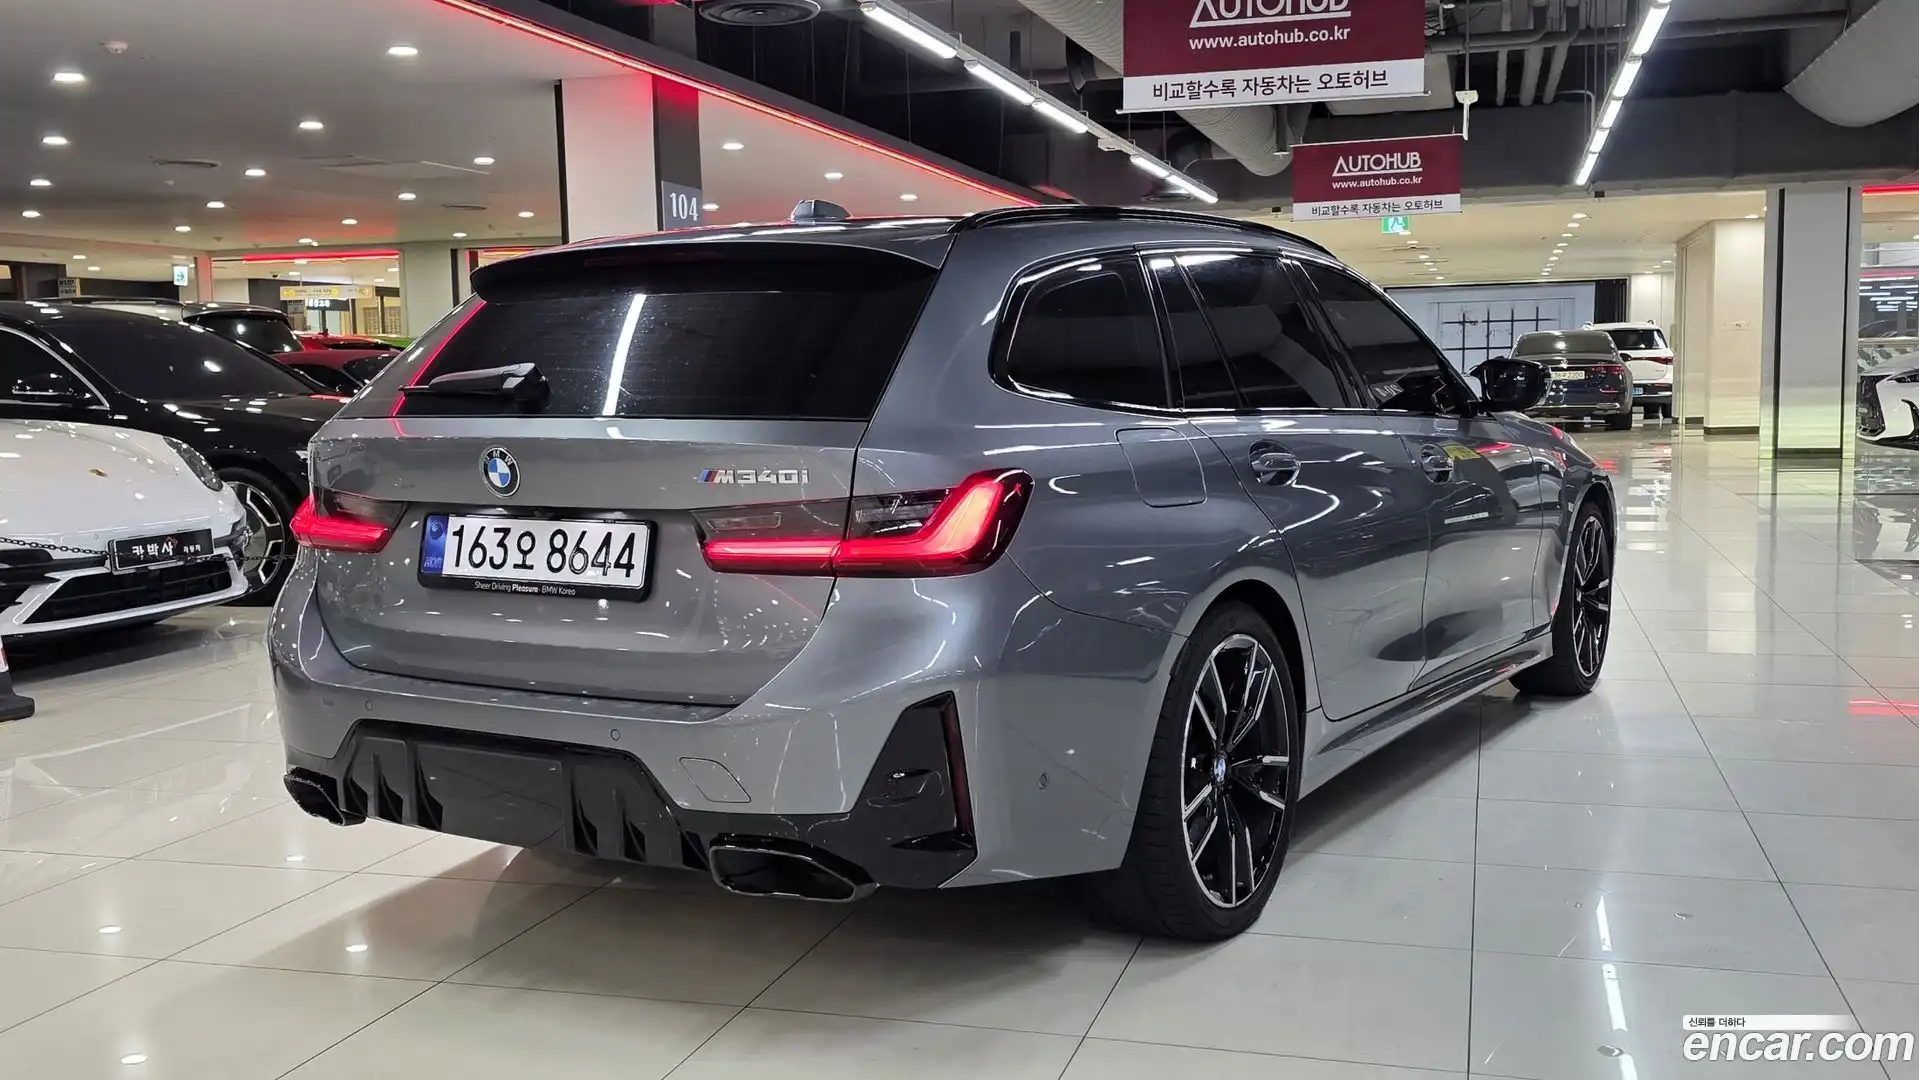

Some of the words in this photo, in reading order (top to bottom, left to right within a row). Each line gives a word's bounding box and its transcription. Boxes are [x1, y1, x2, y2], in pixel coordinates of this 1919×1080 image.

[1188, 25, 1351, 50] www.autohub.co.kr
[1152, 79, 1237, 101] 비교할수록
[1242, 74, 1312, 97] 자동차는
[1317, 69, 1389, 91] 오토허브
[1332, 151, 1423, 177] AUTOHUB
[1332, 175, 1423, 189] www.autohub.co.kr
[670, 192, 699, 222] 104
[1311, 203, 1359, 217] 비교할수록
[1362, 202, 1401, 214] 자동차는
[1403, 199, 1444, 211] 오토허브
[714, 469, 808, 484] M340i
[452, 525, 536, 570] 163오
[546, 529, 636, 578] 8644
[474, 581, 491, 590] Sheer
[491, 582, 511, 592] Driving
[512, 583, 539, 593] Pleasure
[541, 585, 557, 594] BMW
[558, 587, 576, 596] Korea
